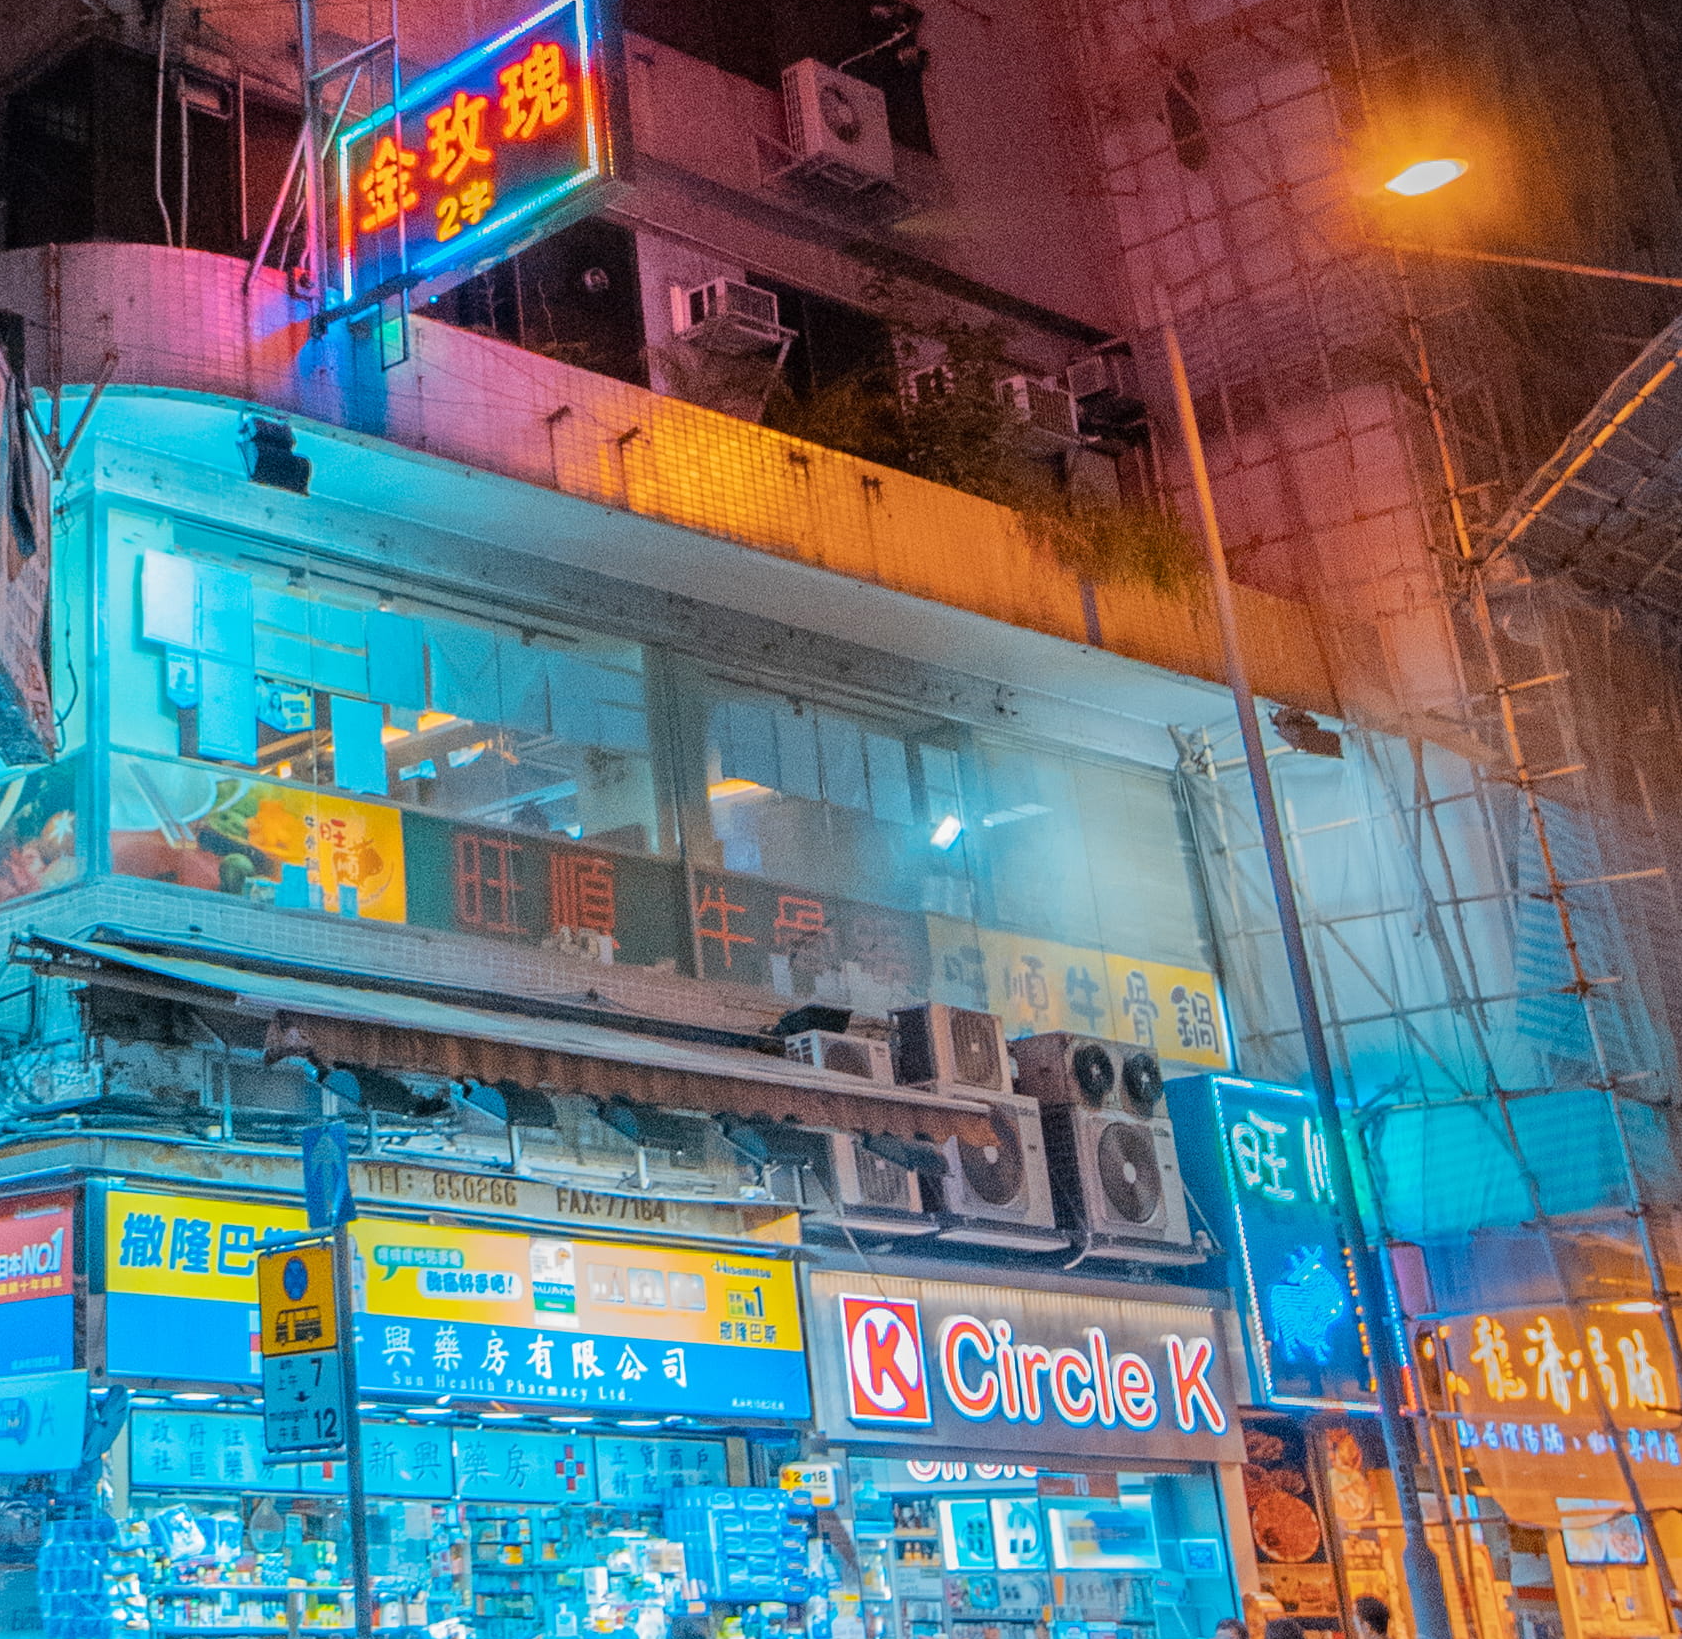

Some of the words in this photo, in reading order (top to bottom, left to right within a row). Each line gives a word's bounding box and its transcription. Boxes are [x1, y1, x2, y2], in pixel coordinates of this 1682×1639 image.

[360, 44, 567, 233] 金玫瑰
[118, 1212, 308, 1277] 撒隆巴
[311, 1358, 322, 1387] 7
[354, 1324, 688, 1388] 興藥房有限公司
[940, 1314, 1159, 1433] Circle
[1166, 1333, 1228, 1436] K
[392, 1371, 424, 1387] Sun
[435, 1374, 495, 1392] Health
[506, 1379, 589, 1403] Pharmacy
[598, 1386, 634, 1402] Ltd.
[151, 1421, 265, 1447] 政府註
[315, 1407, 337, 1438] 12
[368, 1437, 530, 1489] 新興藥房
